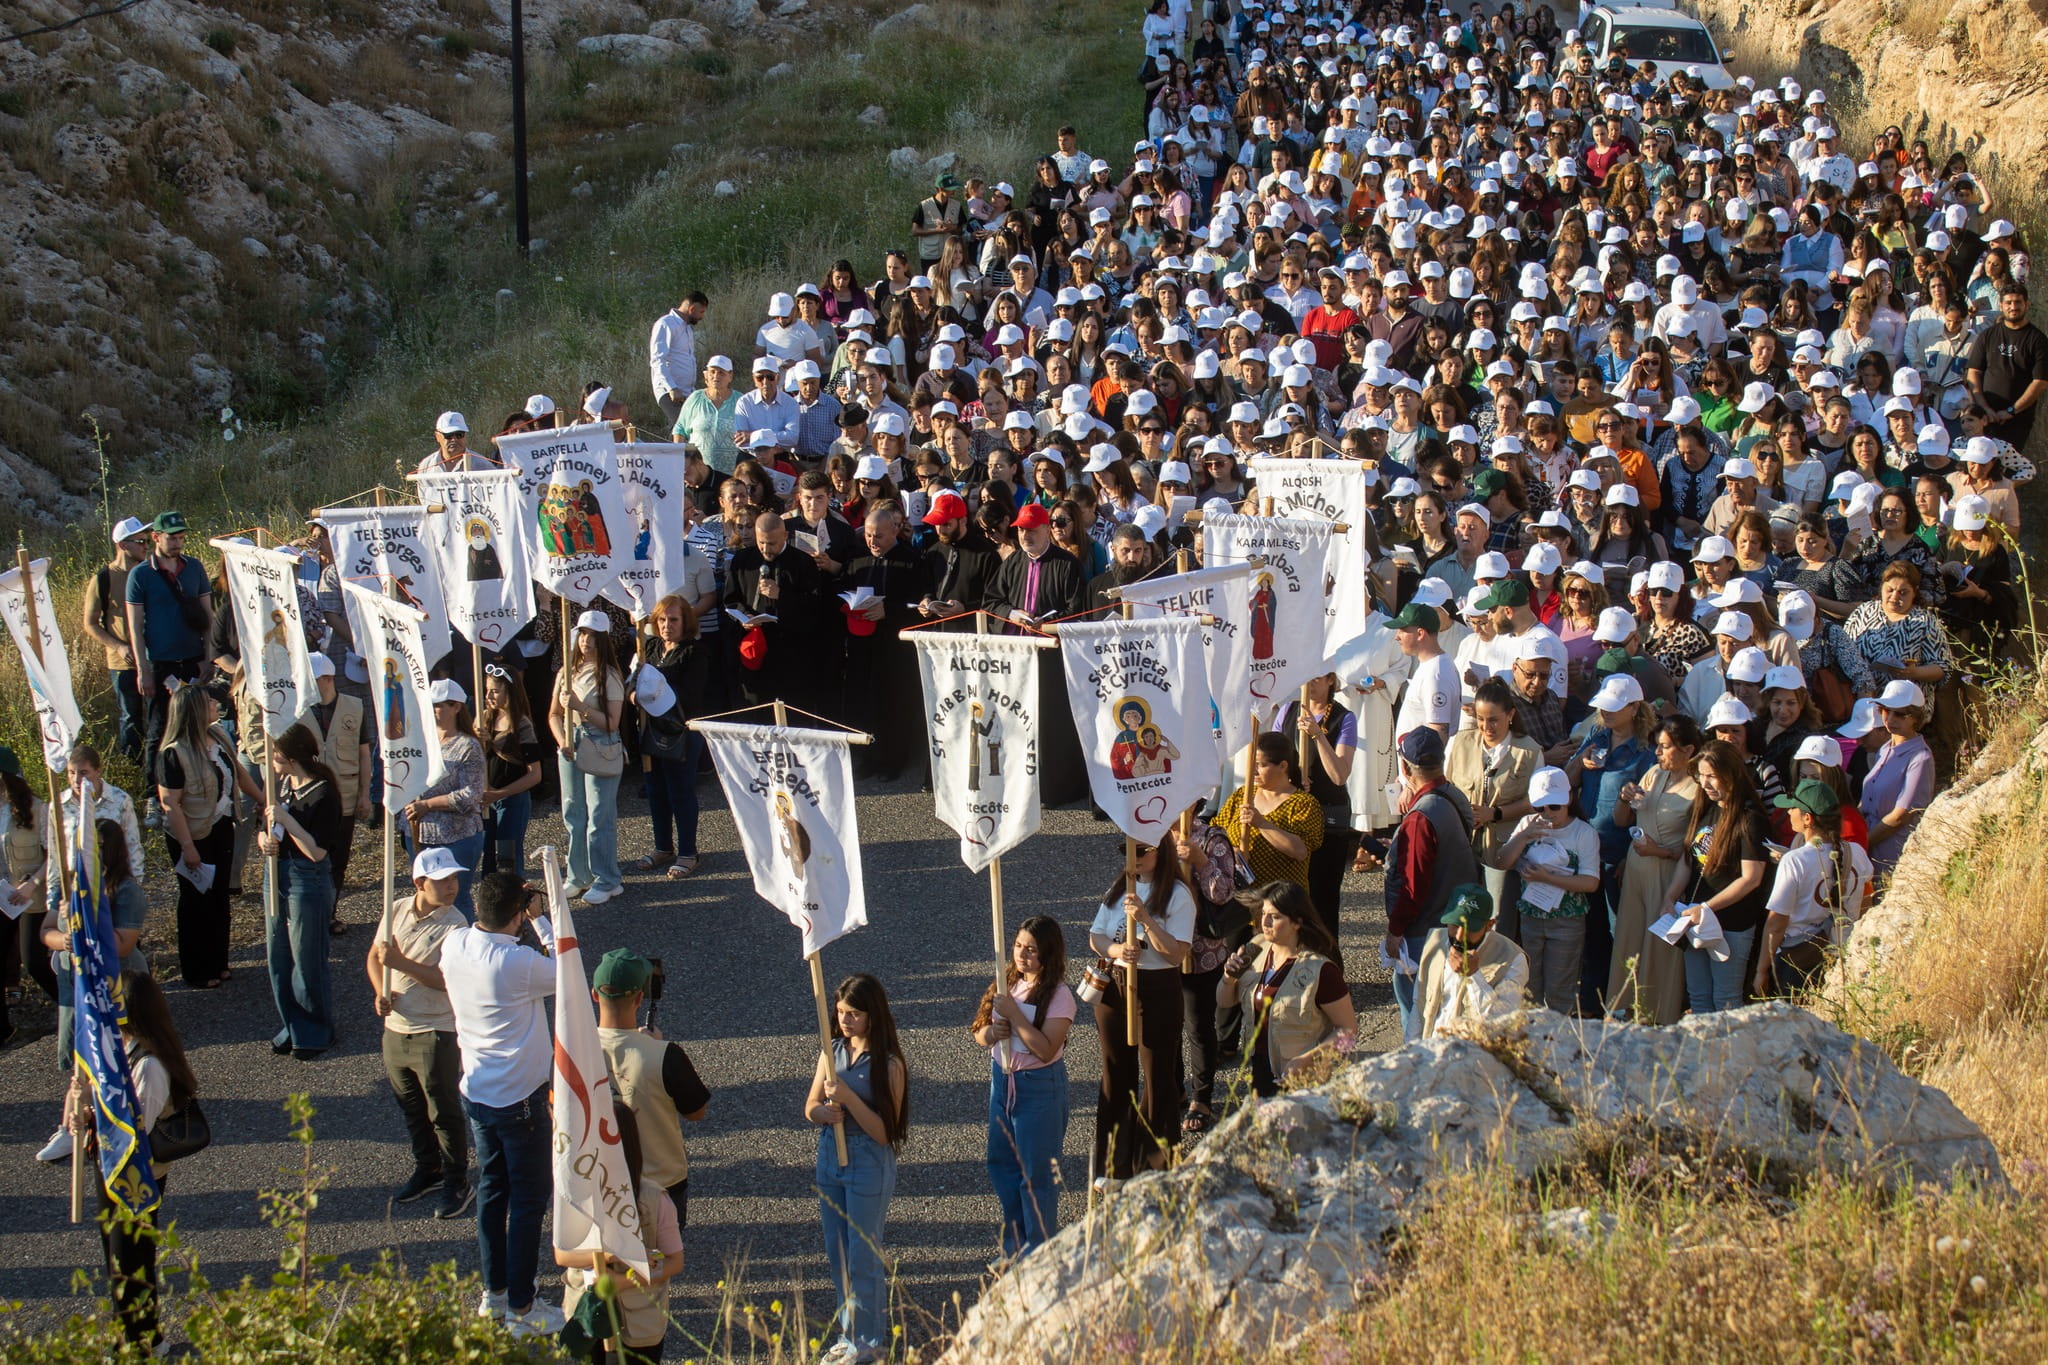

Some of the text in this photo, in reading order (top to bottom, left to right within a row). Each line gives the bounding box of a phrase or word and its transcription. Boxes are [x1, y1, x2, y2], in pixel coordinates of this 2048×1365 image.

[530, 442, 588, 460] BARTELLA
[617, 458, 653, 470] UHOK
[519, 478, 538, 496] St
[534, 457, 611, 486] Schmoney
[629, 471, 667, 500] Alaha
[1281, 476, 1322, 488] ALQOSH
[1285, 490, 1345, 522] Michel
[1236, 537, 1301, 551] KARAMLESS
[355, 541, 425, 575] St Georges
[551, 560, 608, 578] Pentecôte
[620, 567, 661, 580] tecôte
[255, 585, 297, 621] HOMAS
[1157, 588, 1214, 615] TELKIF
[1094, 639, 1155, 655] BATNAYA
[386, 636, 426, 690] MONASTERY
[1088, 651, 1168, 687] Ste Julieta
[1249, 657, 1287, 672] ntecôte
[262, 679, 296, 690] tecôte
[1110, 668, 1173, 693] Cyricus
[934, 684, 978, 727] RABBAN
[384, 747, 423, 760] tecôte
[932, 735, 946, 759] ST
[750, 765, 821, 808] St Joseph
[1116, 775, 1172, 794] Pentecôte
[966, 801, 1009, 814] tecôte
